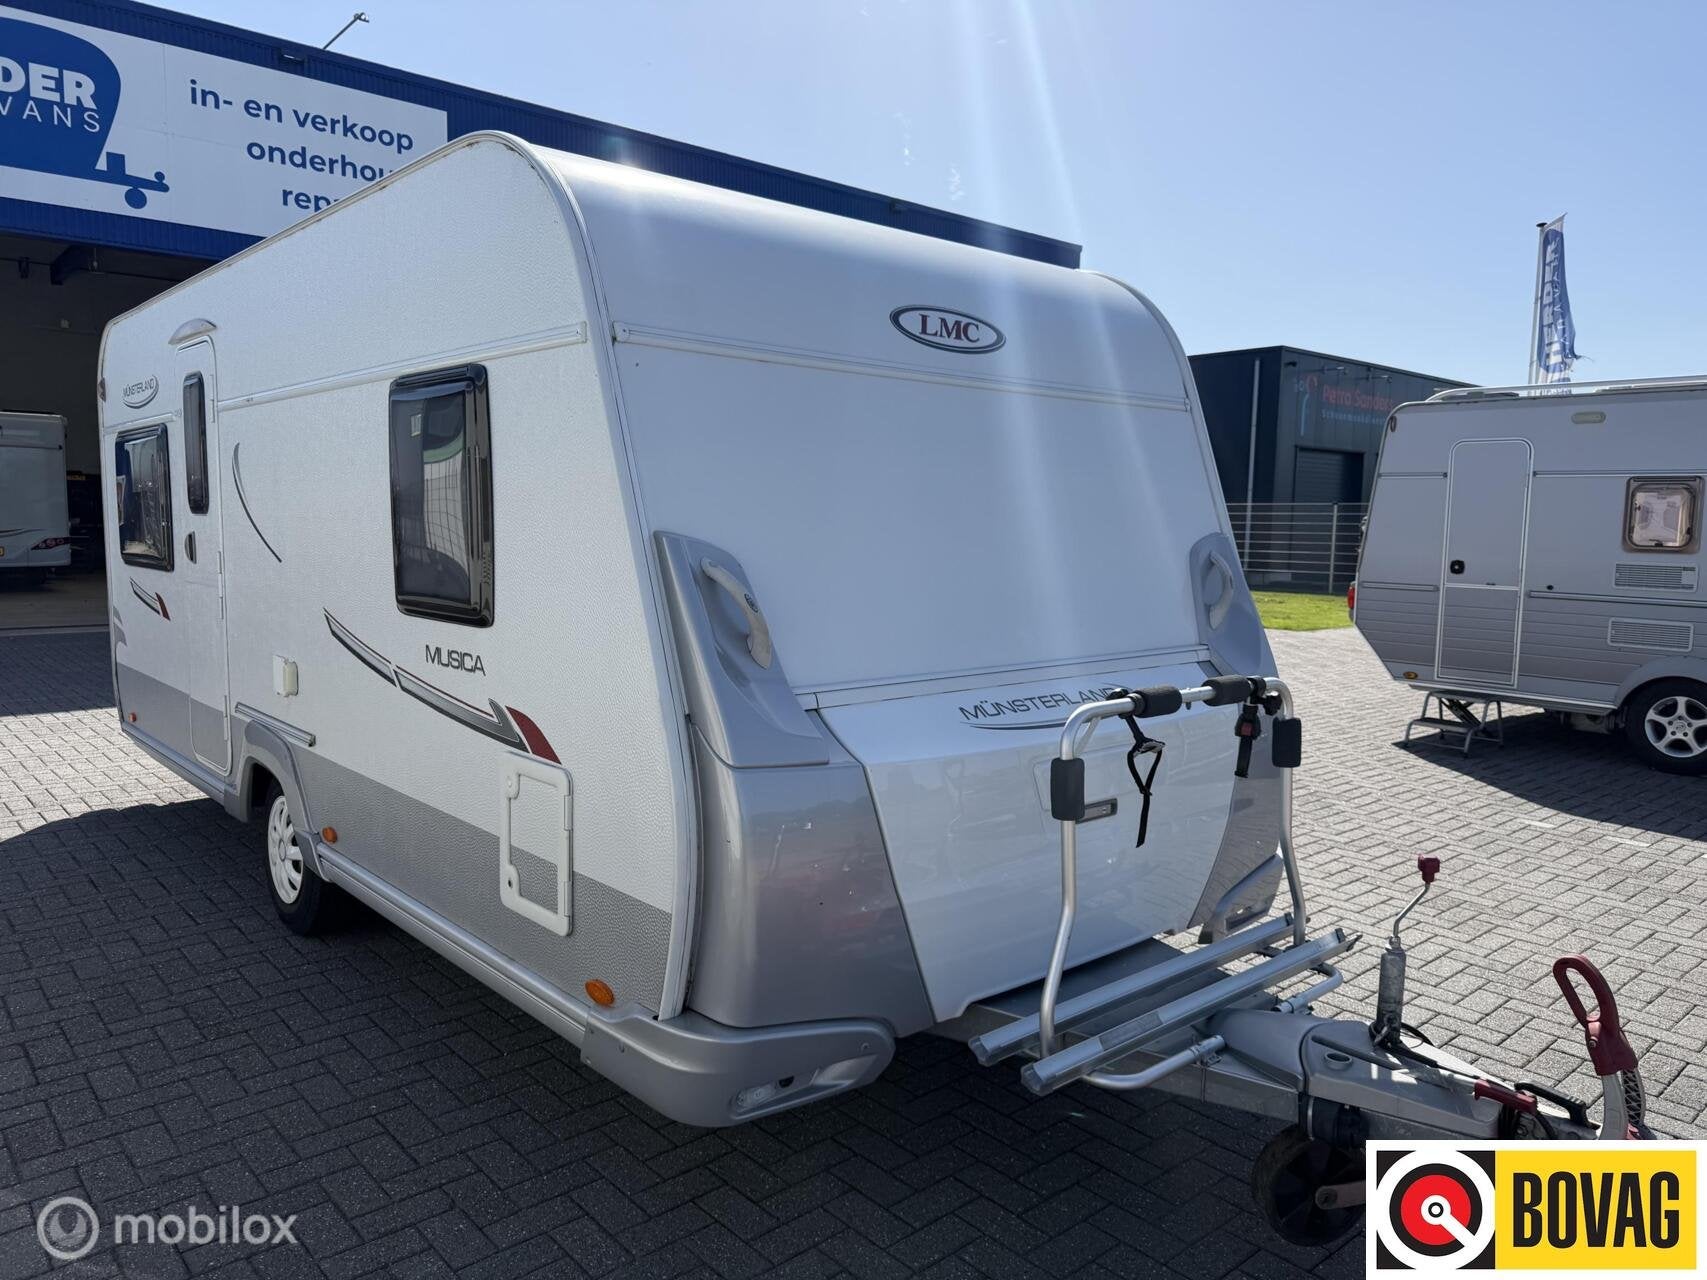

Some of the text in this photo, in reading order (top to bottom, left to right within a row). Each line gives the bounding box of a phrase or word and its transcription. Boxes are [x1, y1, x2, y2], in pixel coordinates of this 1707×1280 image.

[0, 56, 98, 110] DER
[189, 79, 414, 154] in- en verkoop
[282, 188, 341, 213] rep
[918, 313, 980, 344] LMC
[425, 644, 486, 677] MUSICA
